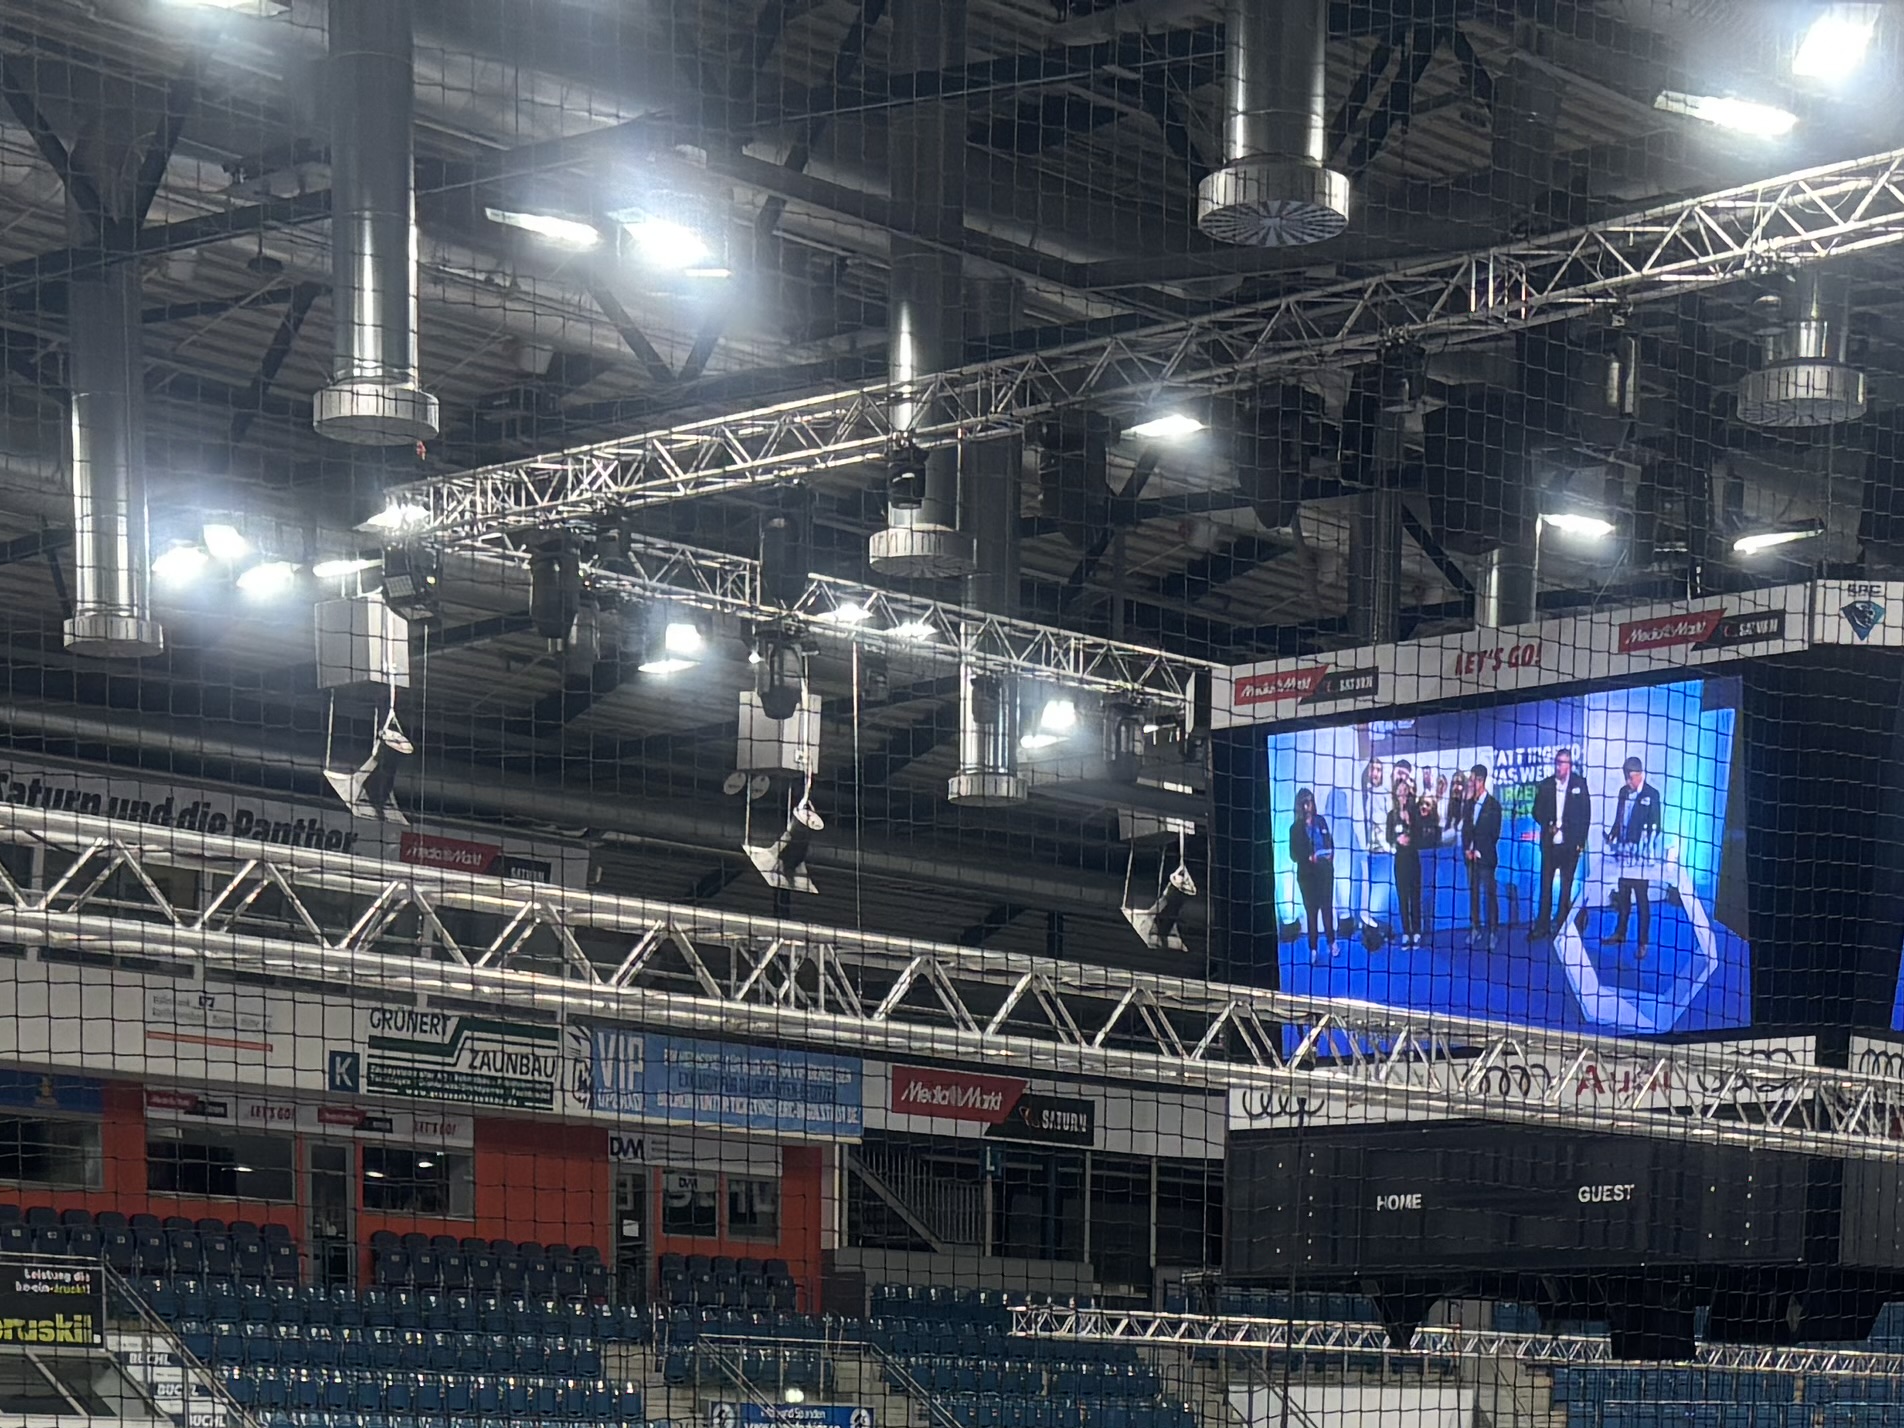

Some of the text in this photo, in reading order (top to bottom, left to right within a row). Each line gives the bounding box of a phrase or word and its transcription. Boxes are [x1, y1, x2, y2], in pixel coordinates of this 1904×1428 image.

[1454, 641, 1542, 676] LET'S GO!
[368, 1007, 452, 1038] GRÜNERT
[469, 1049, 556, 1079] ZAUNBAU
[597, 1033, 645, 1091] VIP
[1576, 1183, 1636, 1203] GUEST
